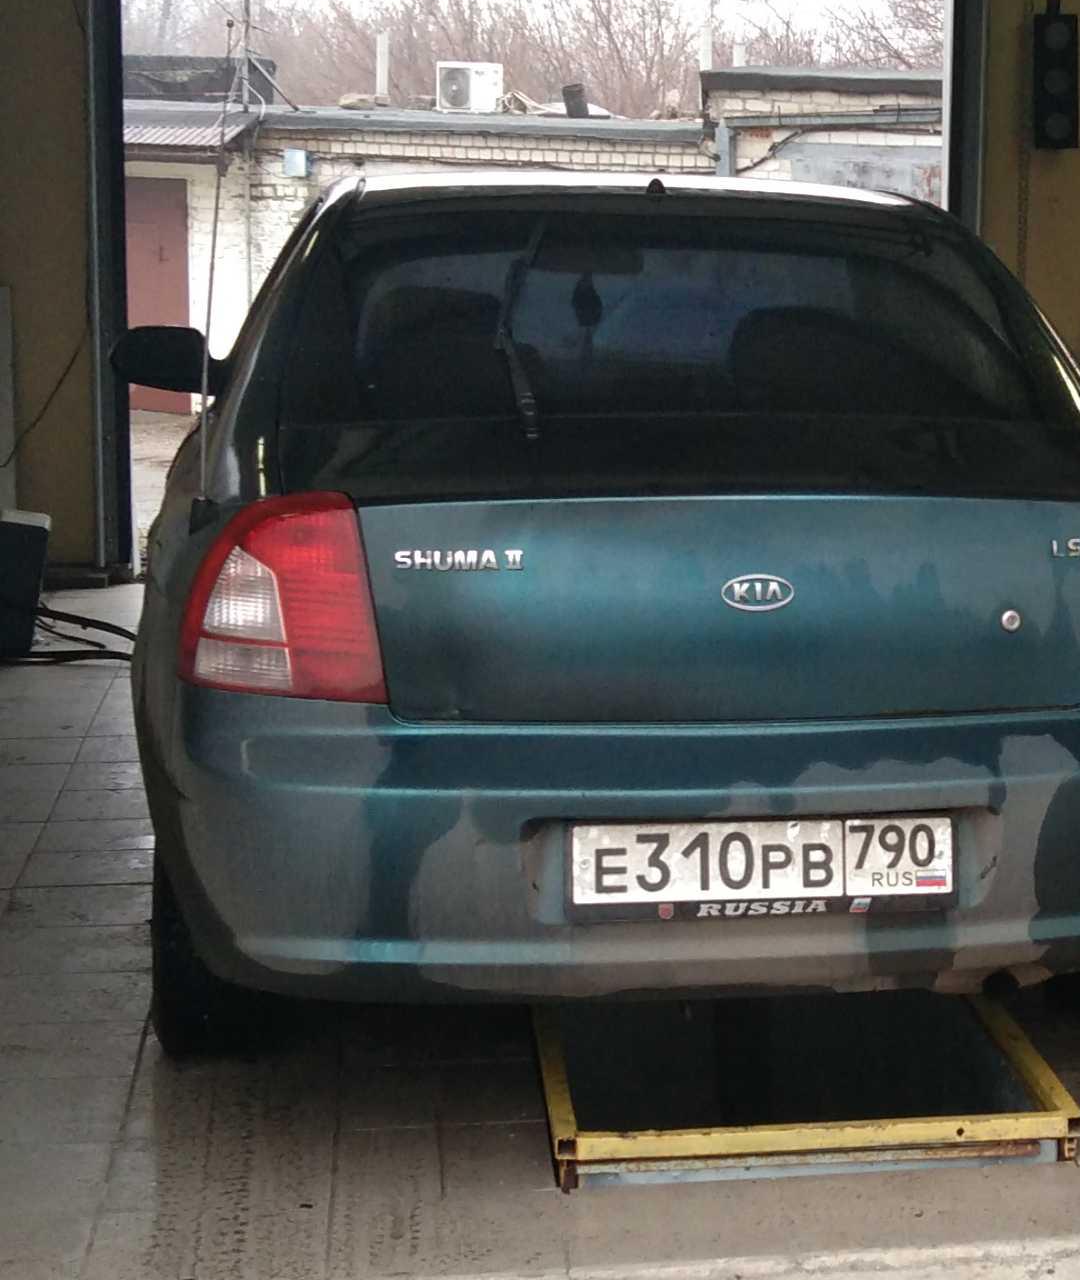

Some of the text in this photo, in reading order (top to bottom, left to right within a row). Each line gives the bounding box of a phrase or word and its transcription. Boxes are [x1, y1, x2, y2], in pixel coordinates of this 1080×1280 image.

[394, 549, 499, 570] SHUMA
[733, 581, 783, 601] KIA
[594, 823, 936, 894] Е310РВ 790
[871, 871, 914, 887] RUS
[696, 899, 829, 918] RUSSIA
